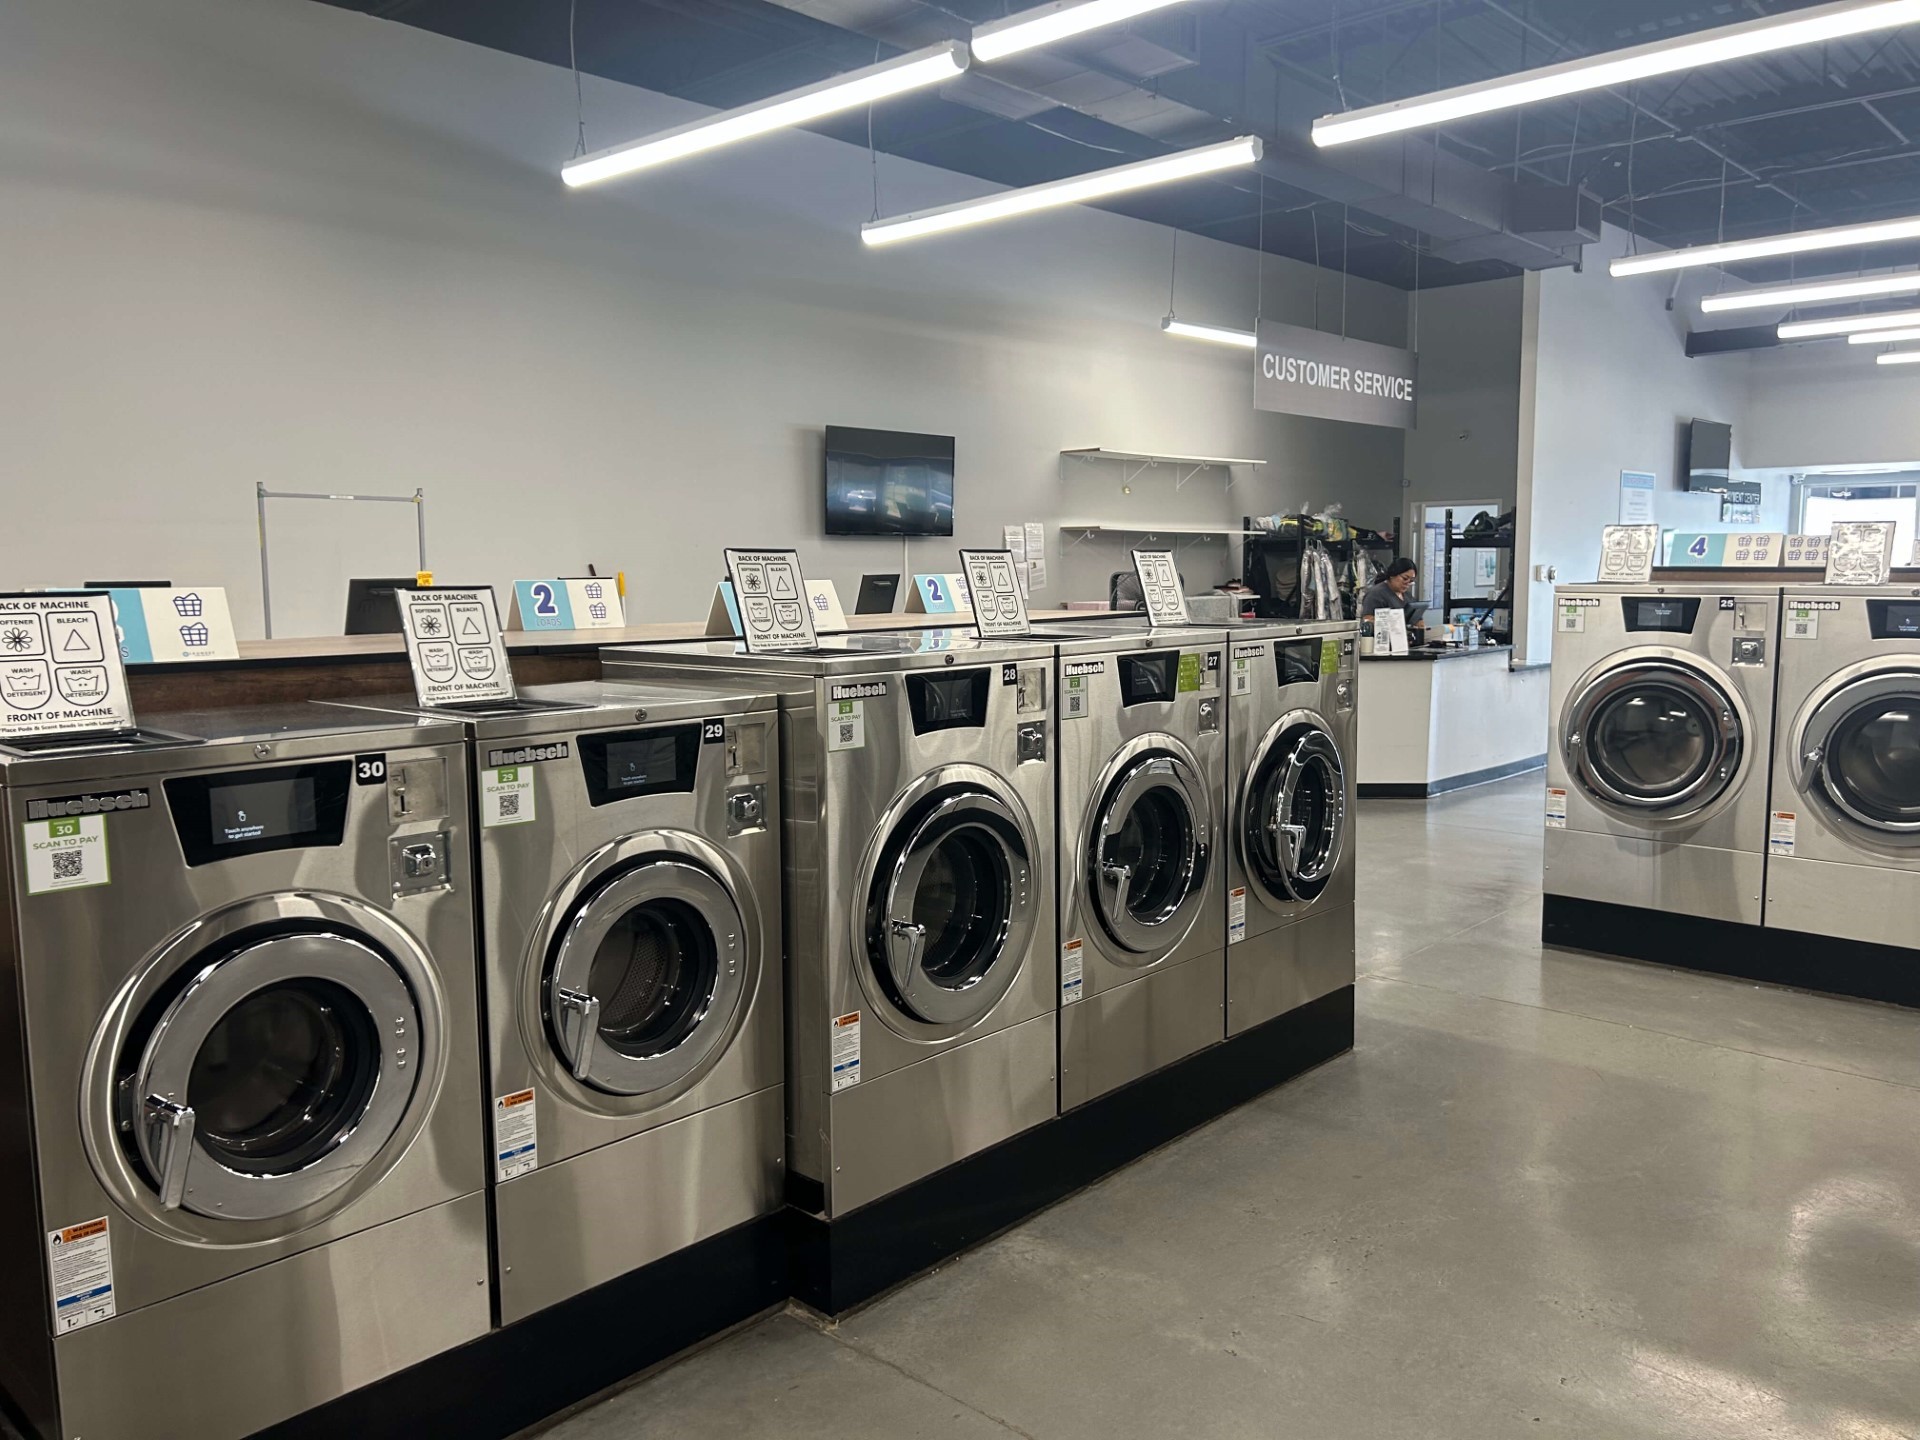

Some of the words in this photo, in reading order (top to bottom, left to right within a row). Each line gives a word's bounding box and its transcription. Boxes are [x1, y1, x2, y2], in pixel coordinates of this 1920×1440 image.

[1262, 353, 1350, 391] CUSTOMER
[1354, 369, 1412, 401] SERVICE
[1689, 536, 1706, 556] 4
[927, 579, 943, 601] 2
[533, 584, 556, 614] 2
[1720, 599, 1733, 607] 25
[1789, 601, 1839, 609] Huebsch
[0, 602, 20, 610] ACK
[40, 601, 89, 609] MACHINE
[537, 618, 561, 626] LOADS
[781, 632, 806, 640] MACHINE
[1208, 656, 1217, 666] 27
[1003, 669, 1016, 680] 28
[1066, 662, 1104, 675] Huebsch
[428, 685, 452, 693] FRONT
[466, 682, 500, 690] MACHINE
[832, 682, 887, 699] Huebsch
[6, 690, 47, 698] DETERGENT
[7, 712, 43, 722] FRONT
[46, 711, 60, 720] OF
[63, 708, 113, 718] MACHINE
[704, 724, 723, 738] 29
[489, 743, 568, 767] Huebsch
[358, 761, 384, 778] 30
[502, 773, 514, 782] 29
[486, 785, 505, 793] SCAN
[28, 790, 149, 819] Huebsch
[56, 825, 73, 835] 30
[32, 841, 60, 850] SCAN
[62, 839, 77, 847] TO
[80, 836, 99, 844] PAY
